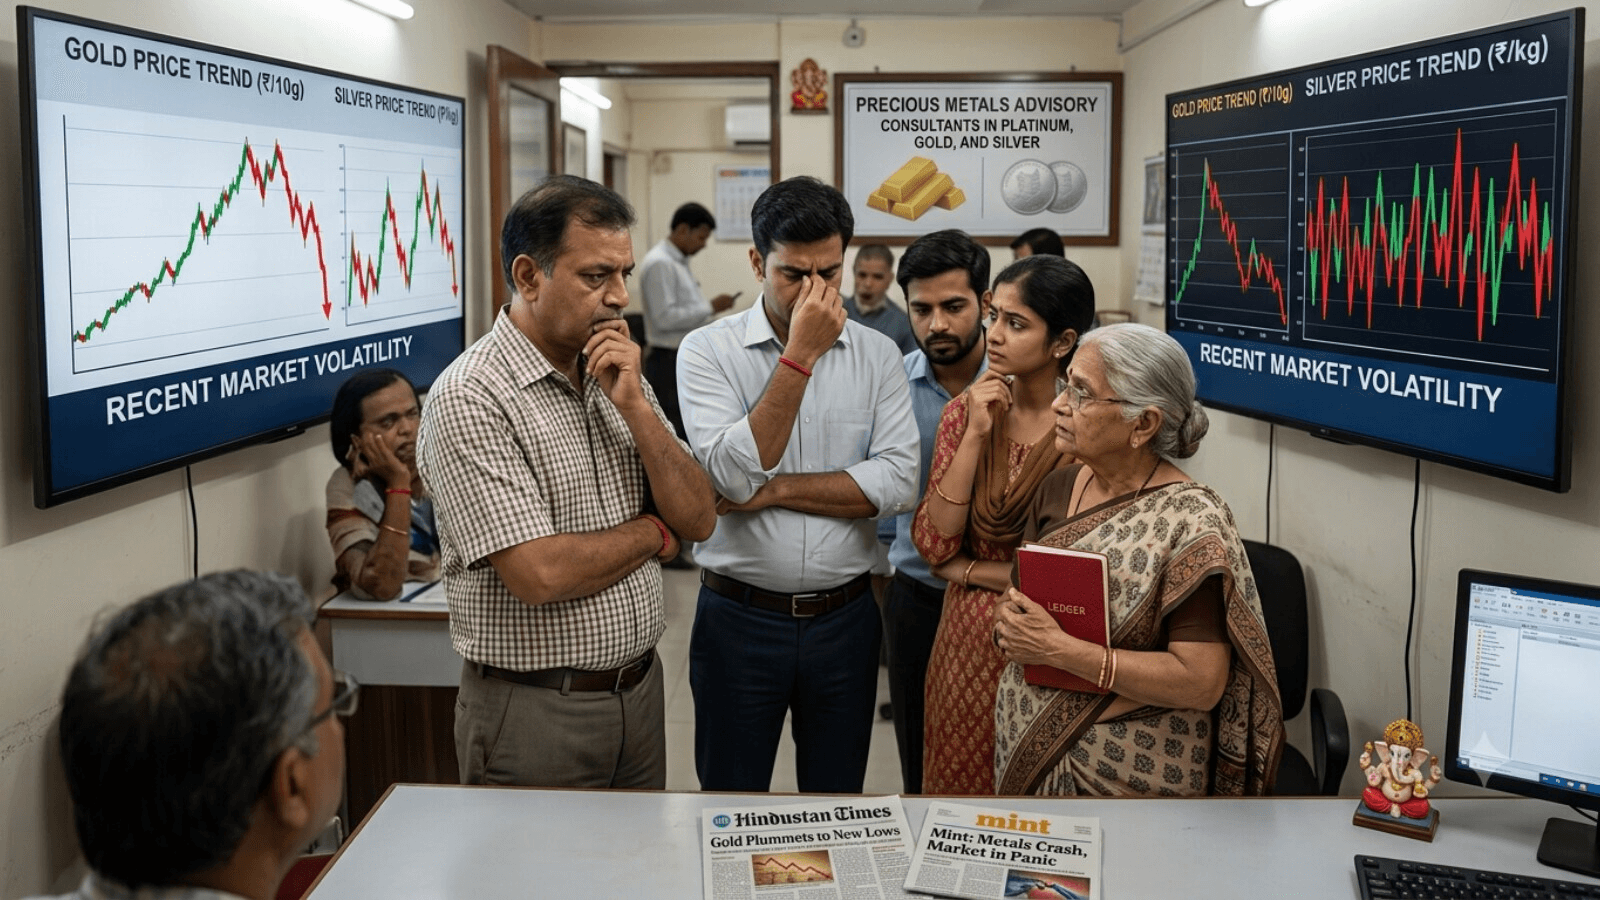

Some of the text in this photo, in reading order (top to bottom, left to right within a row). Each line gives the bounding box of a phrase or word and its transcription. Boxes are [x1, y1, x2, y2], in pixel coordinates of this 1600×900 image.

[64, 36, 304, 101] GOLD PRICE TREND (₹/10g)
[1305, 33, 1549, 97] SILVER PRICE TREND (₹/kg)
[335, 86, 373, 109] SILVER
[375, 94, 404, 114] PRICE
[856, 97, 1098, 113] PRECIOUS METALS ADVISORY
[1172, 101, 1196, 118] GOLD
[1197, 95, 1223, 115] PRICE
[1224, 89, 1257, 109] TREND
[881, 119, 1074, 134] CONSULTANTS IN PLATINUM,
[914, 136, 1040, 150] GOLD, AND SILVER
[106, 335, 413, 425] RECENT MARKET VOLATILITY
[1200, 342, 1503, 414] RECENT MARKET VOLATILITY
[1047, 601, 1086, 615] LEDGER
[734, 810, 832, 828] Hindustan
[834, 806, 892, 821] Times
[976, 812, 1051, 835] mint
[710, 835, 743, 848] Gold
[746, 831, 815, 847] Plummets
[816, 831, 831, 841] to
[833, 828, 863, 840] New
[865, 826, 901, 837] Lows
[930, 827, 1088, 859] Mint: Metals Crash,
[927, 840, 1058, 867] Market in Panic
